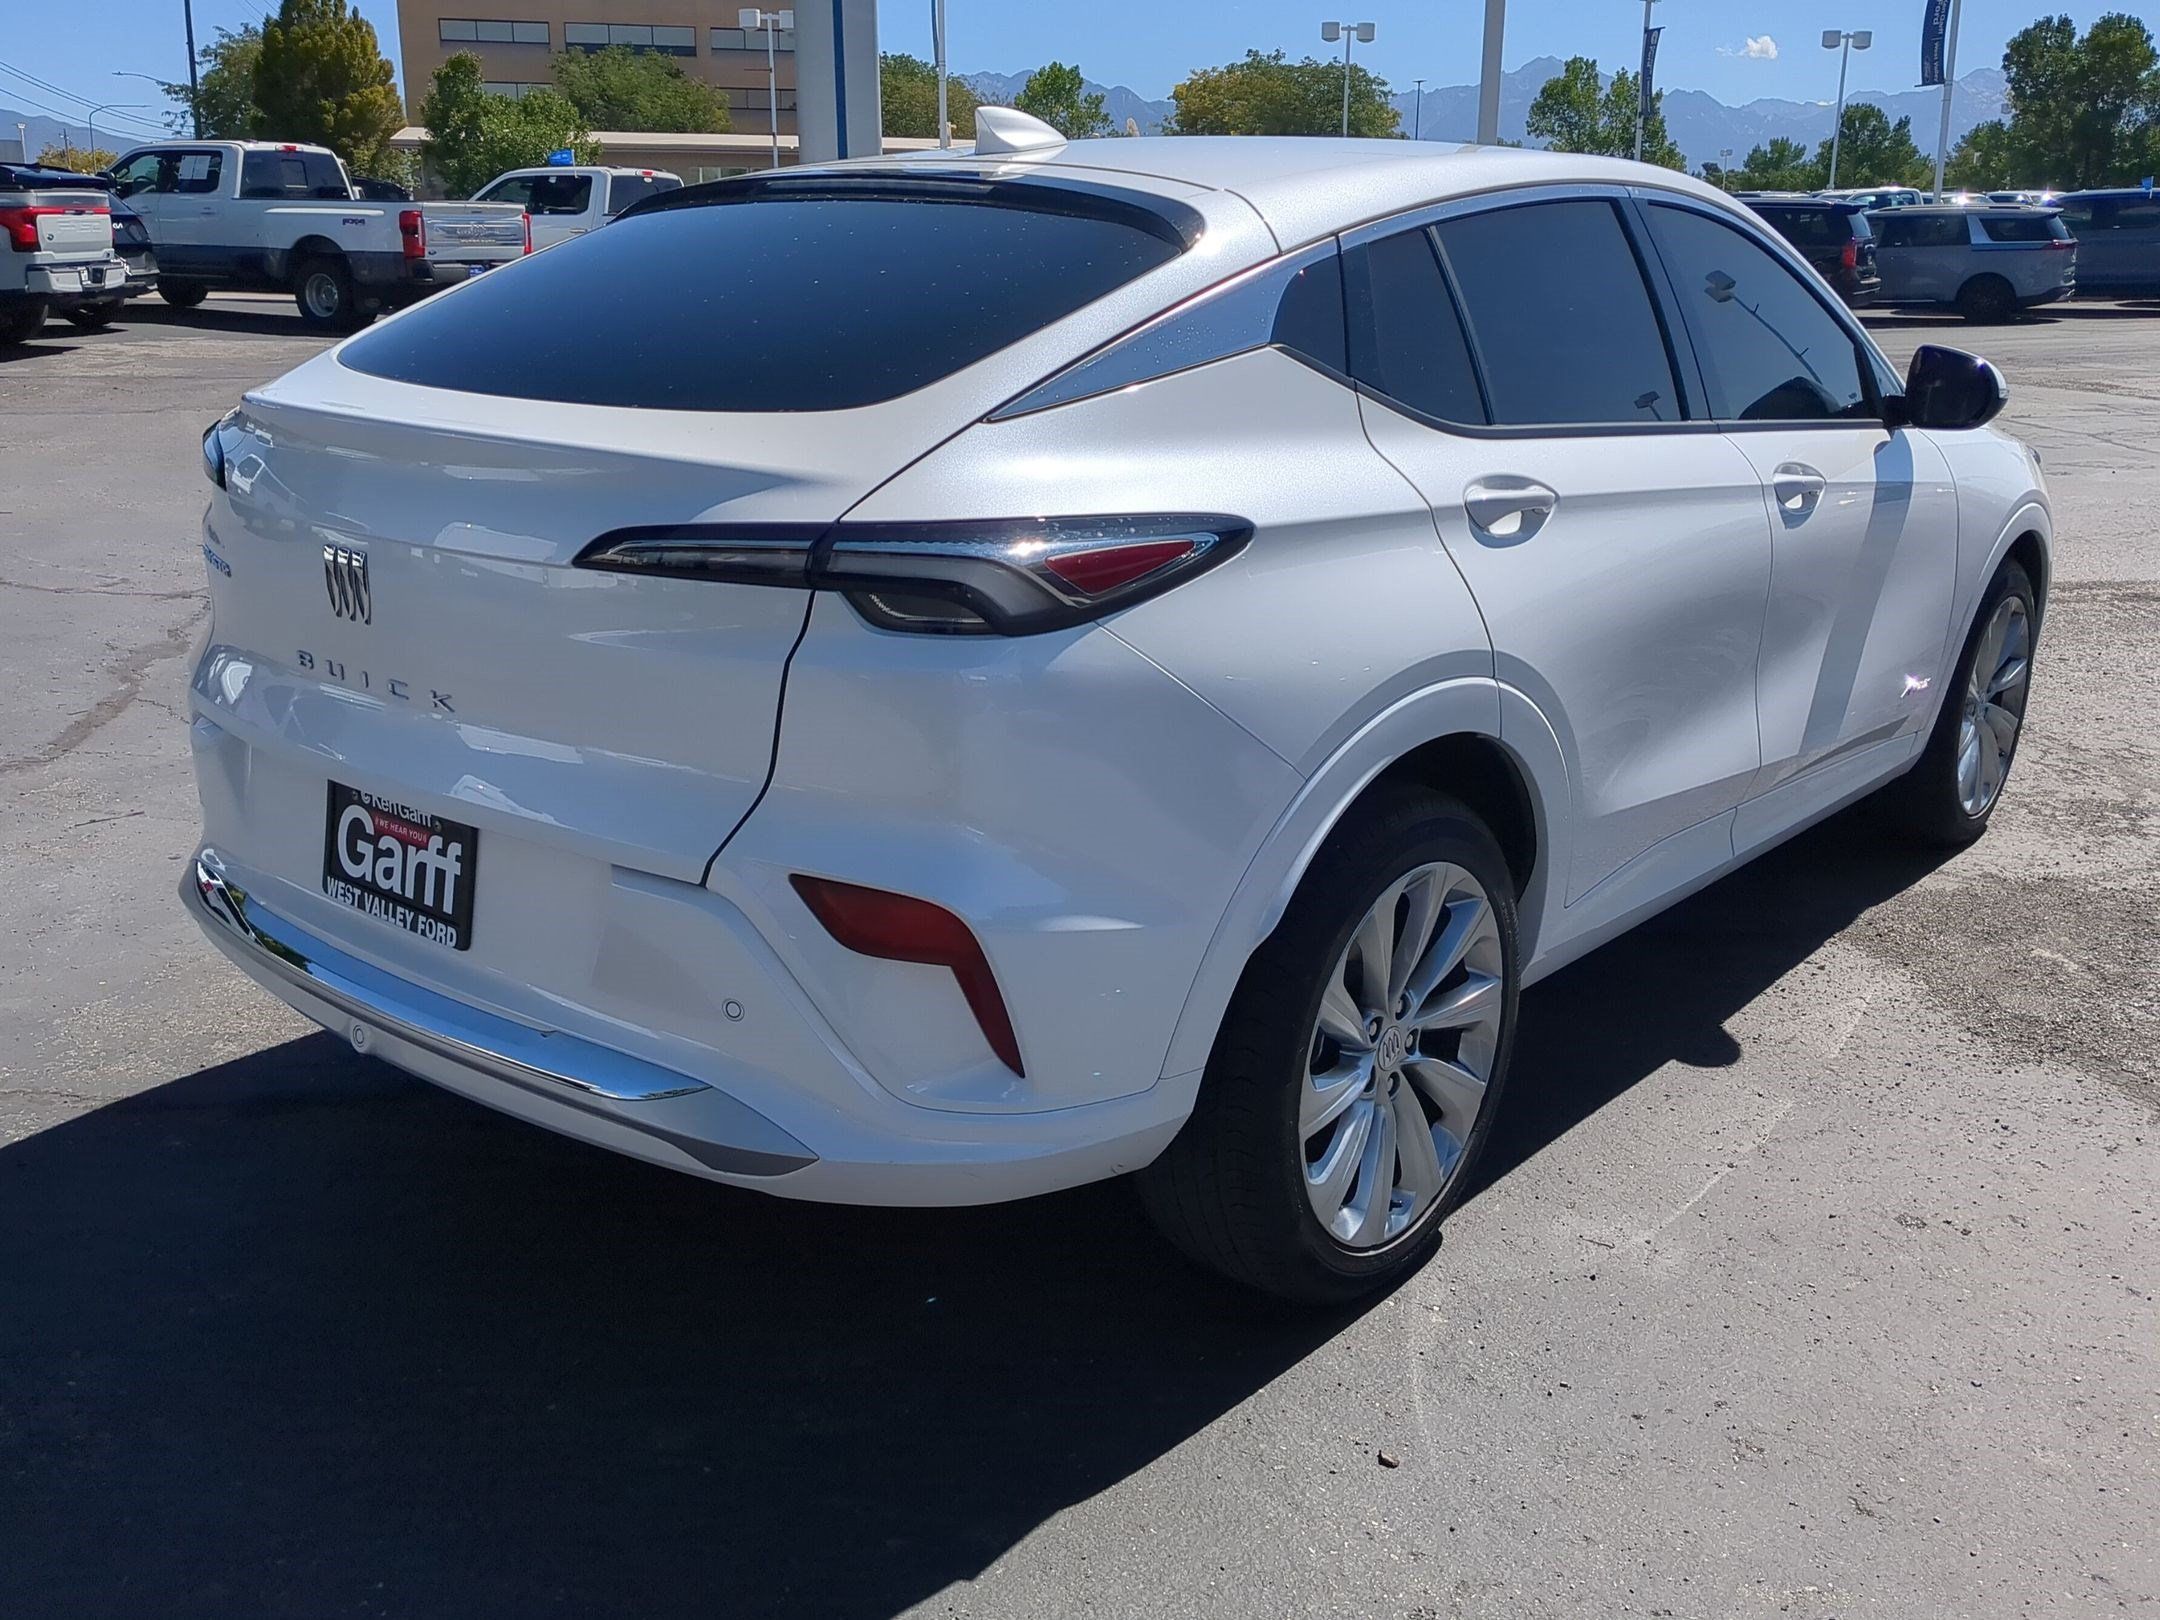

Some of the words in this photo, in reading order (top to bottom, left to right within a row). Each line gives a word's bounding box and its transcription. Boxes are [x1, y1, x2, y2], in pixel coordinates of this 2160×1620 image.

[298, 650, 455, 712] BUICK
[338, 804, 462, 915] Garff
[379, 819, 389, 829] WE
[390, 822, 408, 836] HEAR
[327, 876, 361, 908] WEST
[364, 892, 414, 930] VALLEY
[417, 914, 457, 947] FORD
